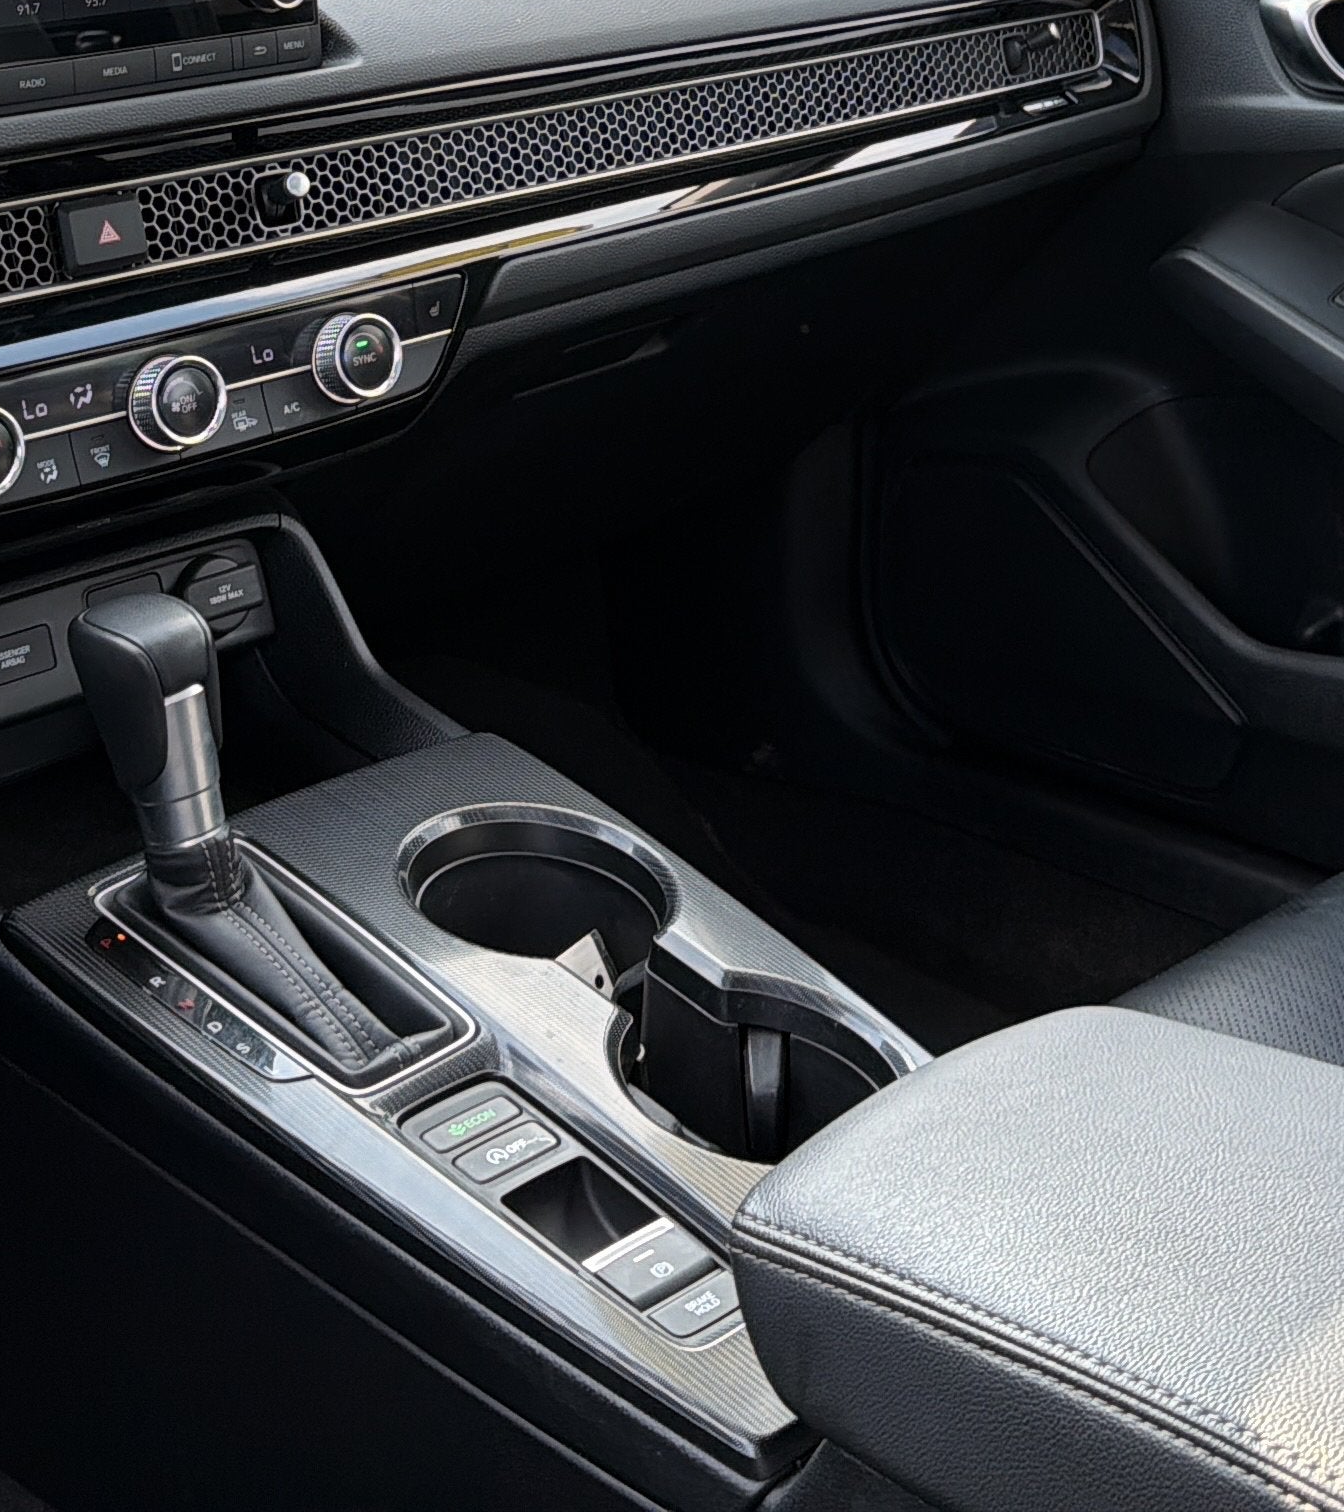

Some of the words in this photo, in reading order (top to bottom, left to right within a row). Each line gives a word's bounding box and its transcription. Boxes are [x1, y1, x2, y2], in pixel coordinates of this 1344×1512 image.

[16, 1, 41, 17] 91.7
[282, 39, 306, 52] MENU
[182, 51, 217, 66] CONNECT
[102, 64, 128, 78] MEDIA
[19, 76, 47, 91] RADIO
[251, 345, 274, 365] Lo
[352, 351, 377, 367] SYNC
[180, 394, 197, 405] ON/
[21, 399, 48, 420] Lo
[182, 402, 198, 414] OFF
[283, 402, 301, 415] A/C
[90, 445, 111, 456] FRONT
[36, 458, 55, 469] MODE
[227, 588, 244, 600] MAX
[0, 656, 26, 670] AIRBAG
[149, 975, 166, 989] R
[206, 1021, 223, 1034] D
[235, 1042, 251, 1055] S
[463, 1108, 497, 1129] ECON
[505, 1137, 528, 1154] OFF
[683, 1291, 716, 1312] BRAKE
[694, 1298, 721, 1317] HOLD
